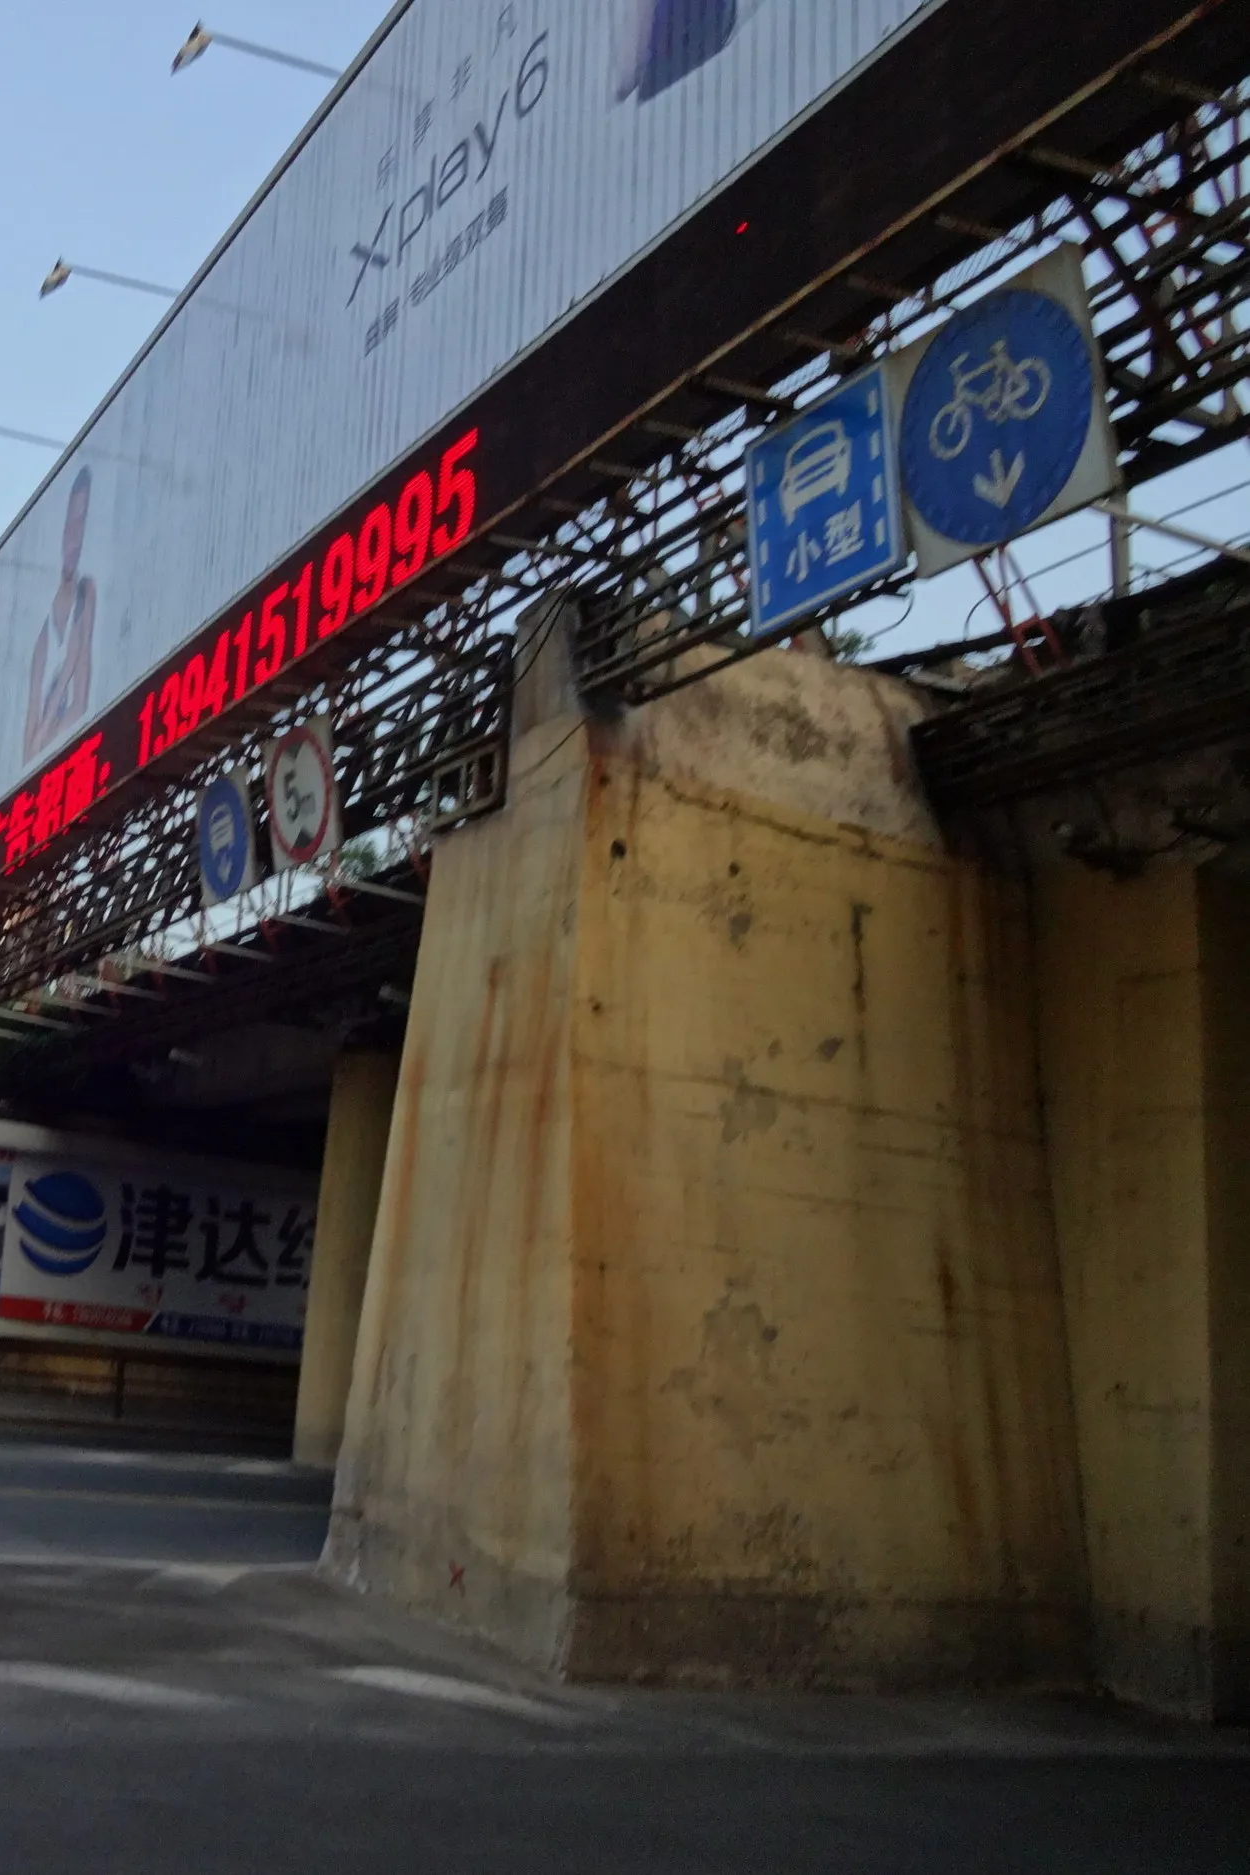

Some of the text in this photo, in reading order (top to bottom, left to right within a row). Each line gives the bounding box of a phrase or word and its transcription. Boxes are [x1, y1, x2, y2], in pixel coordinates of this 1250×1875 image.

[346, 28, 549, 310] Xplay6
[137, 427, 479, 768] 13941519995
[785, 499, 864, 584] 小型
